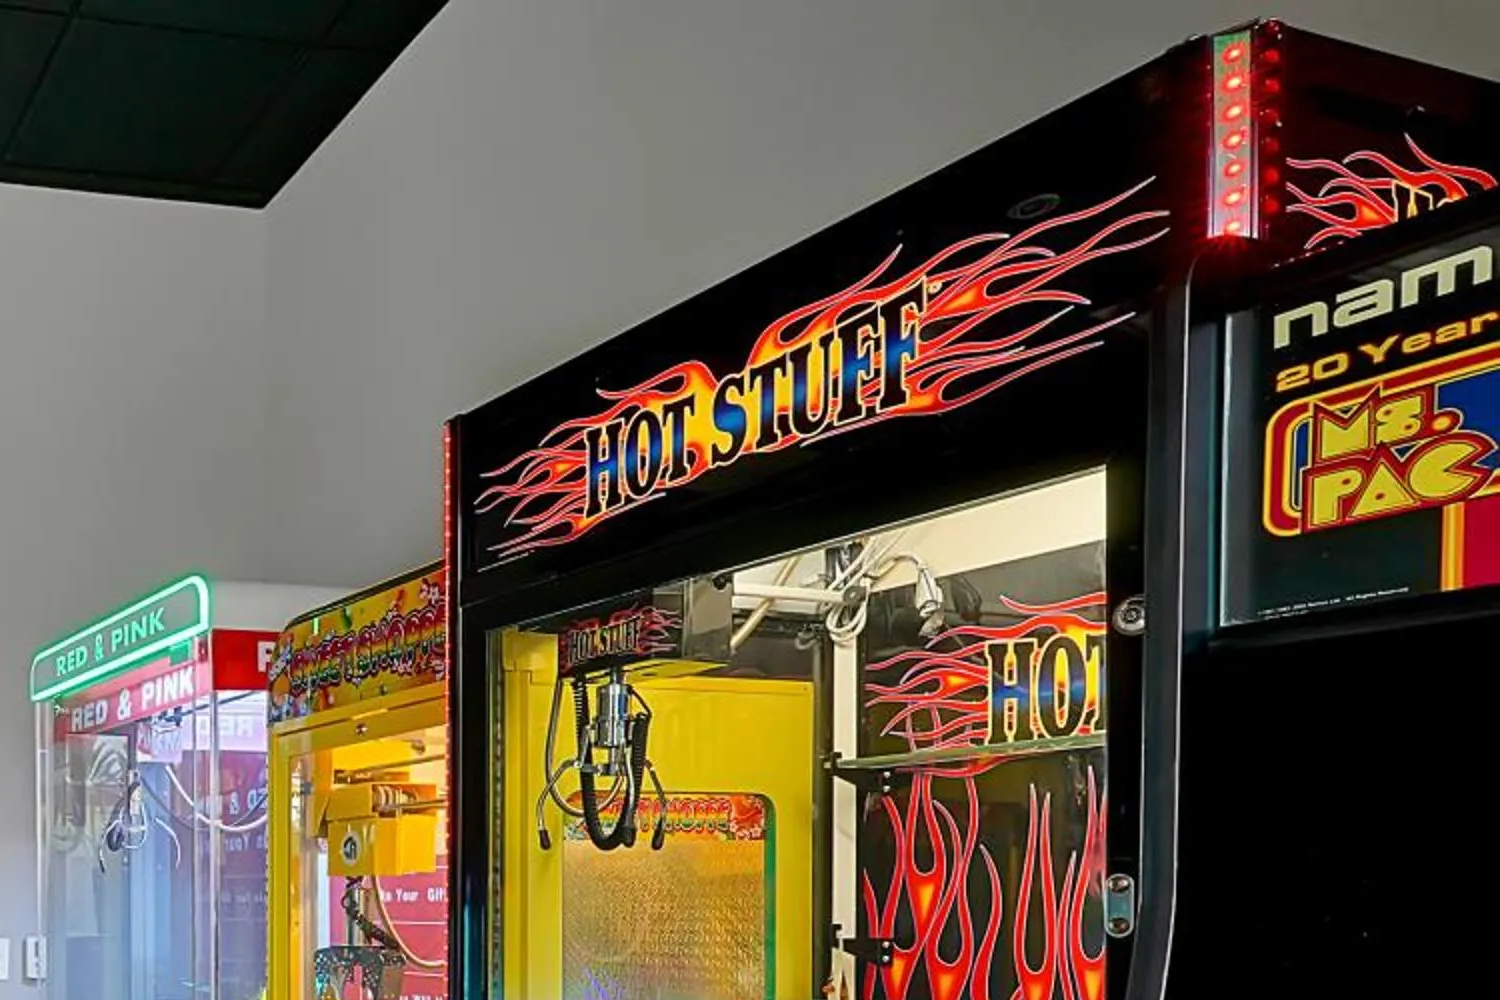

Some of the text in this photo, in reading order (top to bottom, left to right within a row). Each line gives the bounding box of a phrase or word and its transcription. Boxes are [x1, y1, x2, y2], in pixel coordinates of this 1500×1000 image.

[584, 275, 928, 518] HOT STUFF
[1276, 353, 1349, 392] 20
[1311, 440, 1482, 527] PAC
[56, 607, 165, 677] RED & PINK
[71, 666, 194, 733] RED & PINK
